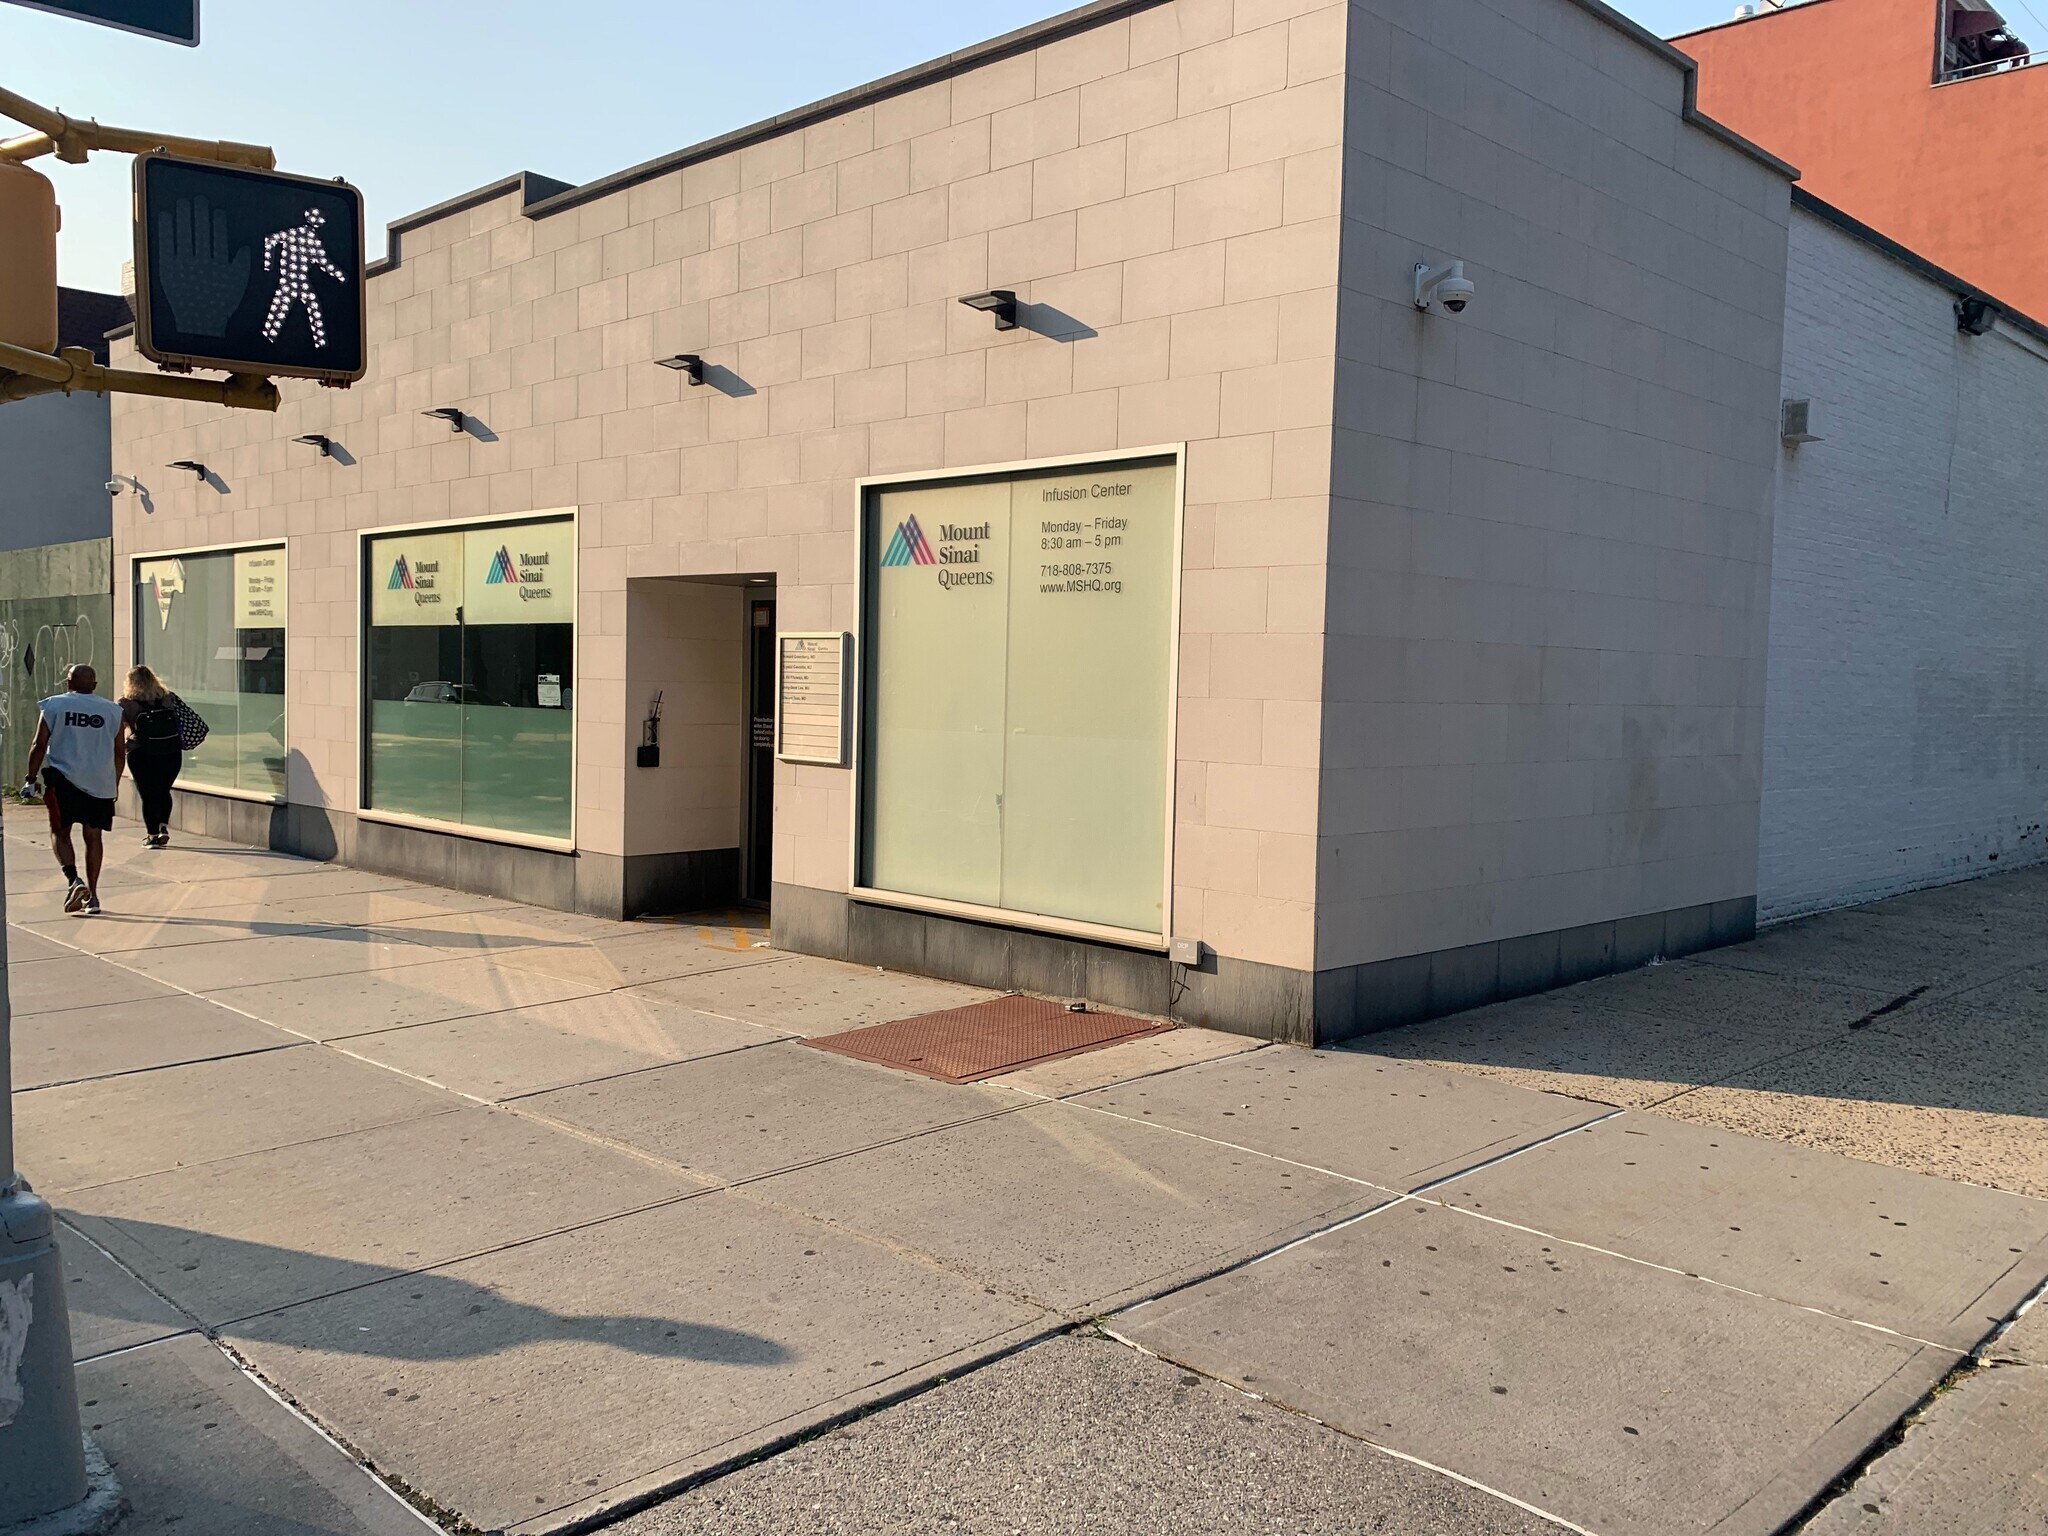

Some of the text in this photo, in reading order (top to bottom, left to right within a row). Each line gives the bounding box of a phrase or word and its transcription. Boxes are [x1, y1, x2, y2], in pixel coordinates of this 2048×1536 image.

[1042, 483, 1132, 502] Infusion Center
[939, 521, 991, 542] Mount
[1041, 520, 1082, 534] Monday
[1094, 517, 1128, 531] Friday
[1041, 537, 1063, 550] 8:30
[1065, 538, 1082, 548] am
[1094, 534, 1101, 547] 5
[1104, 535, 1121, 548] pm
[520, 552, 549, 566] Mount
[939, 543, 980, 565] Sinai
[415, 560, 439, 573] Mount
[1040, 562, 1112, 576] 718-808-7375
[414, 575, 434, 589] Sinai
[520, 568, 543, 583] Sinai
[938, 569, 993, 591] Queens
[519, 586, 552, 602] Queens
[1039, 579, 1122, 593] www.MSHQ.org
[414, 591, 441, 606] Queens
[64, 711, 105, 729] HBO
